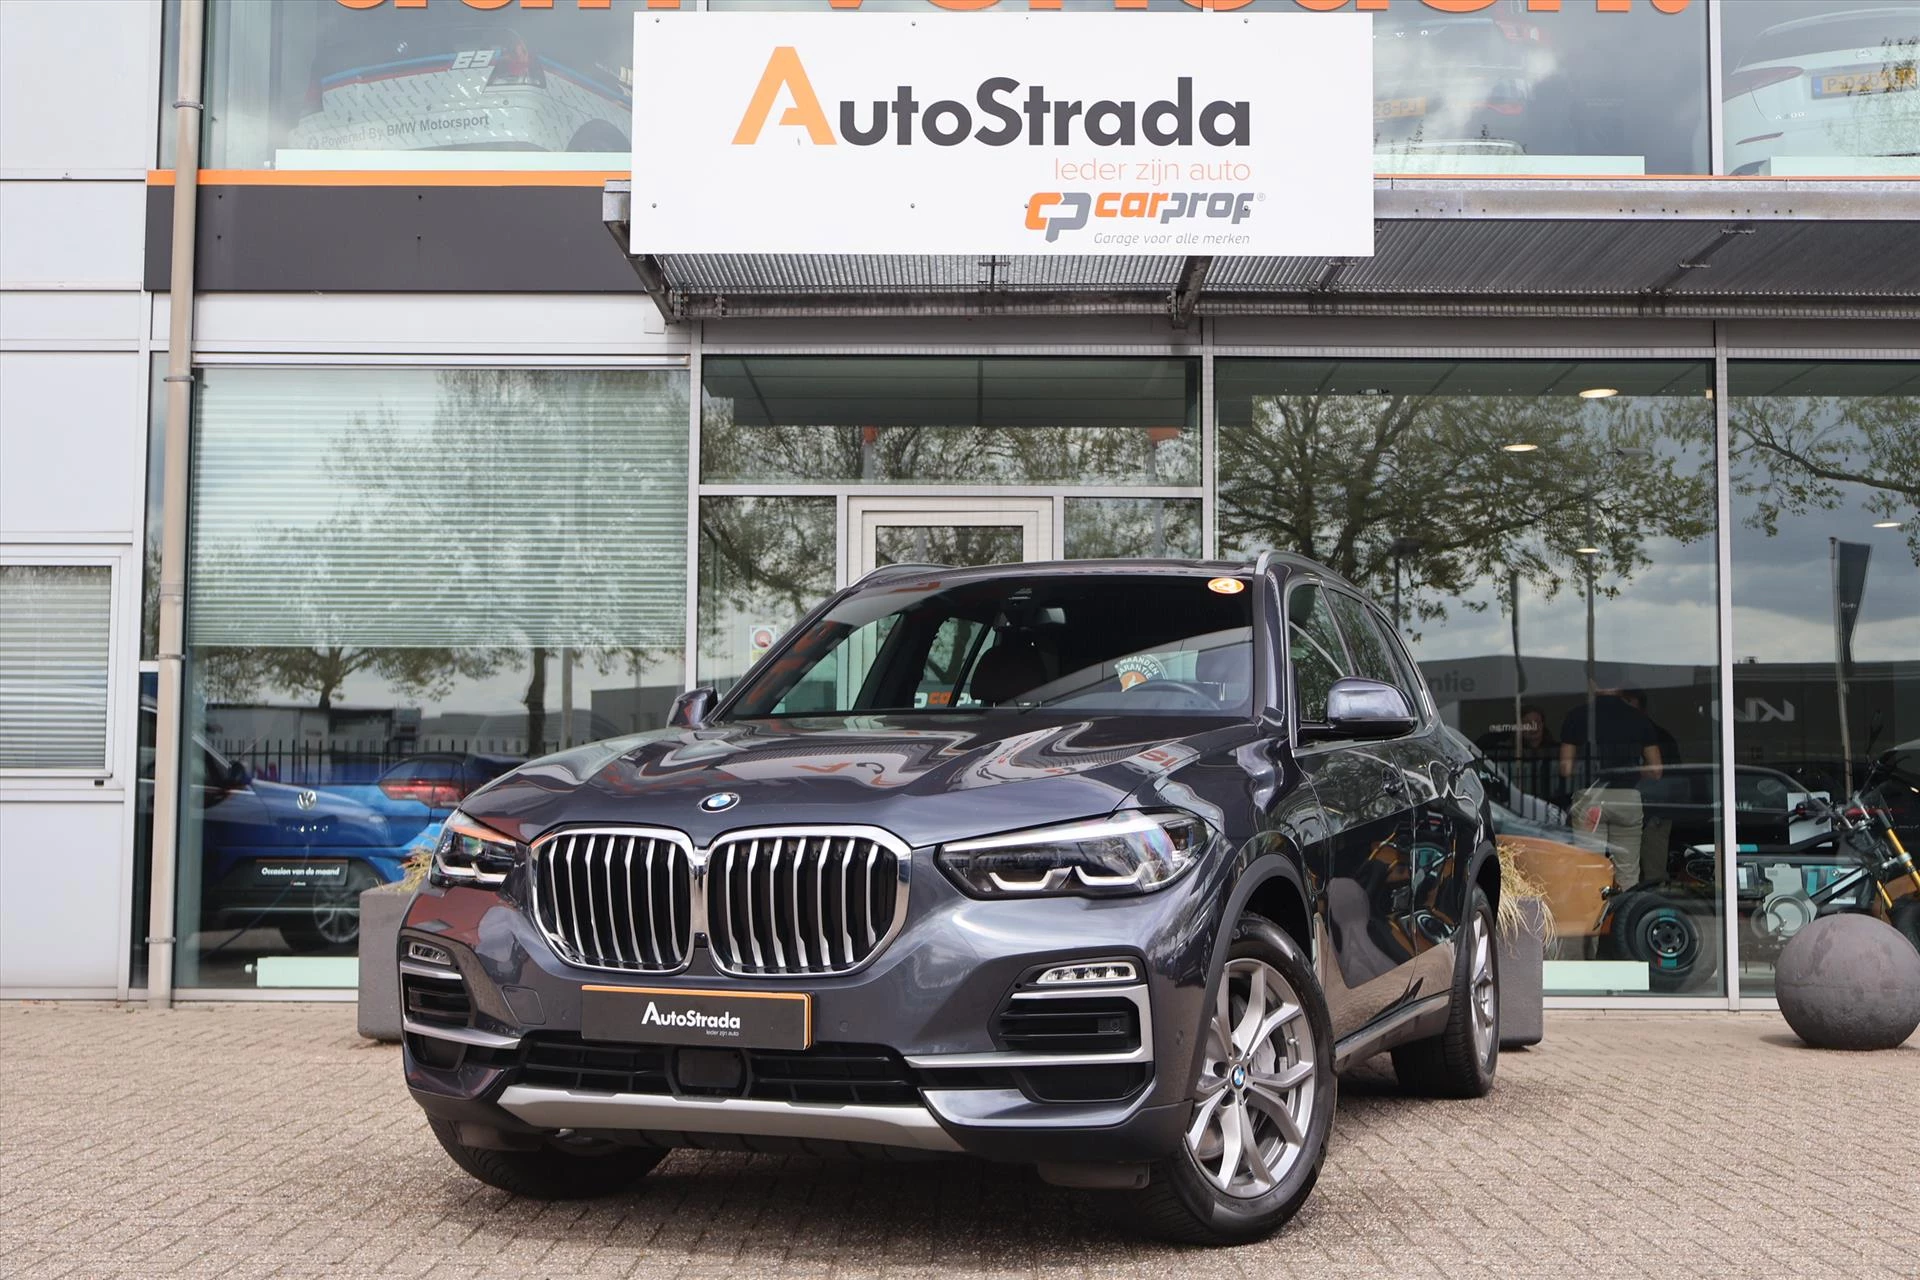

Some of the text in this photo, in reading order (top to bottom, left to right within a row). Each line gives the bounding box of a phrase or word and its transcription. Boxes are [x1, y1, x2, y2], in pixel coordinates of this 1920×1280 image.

[452, 50, 495, 70] 69
[731, 46, 1251, 148] AutoStrada
[387, 121, 417, 137] BMW
[420, 113, 490, 132] Motorsport
[1055, 158, 1250, 186] Ieder zijn auto
[1094, 192, 1255, 224] carprof
[1094, 233, 1250, 247] Garage voor alle merken
[1118, 663, 1153, 680] ARANTIE
[261, 867, 340, 876] Occasion van de maand
[641, 1001, 741, 1029] AutoStrada
[719, 1030, 727, 1038] zijn
